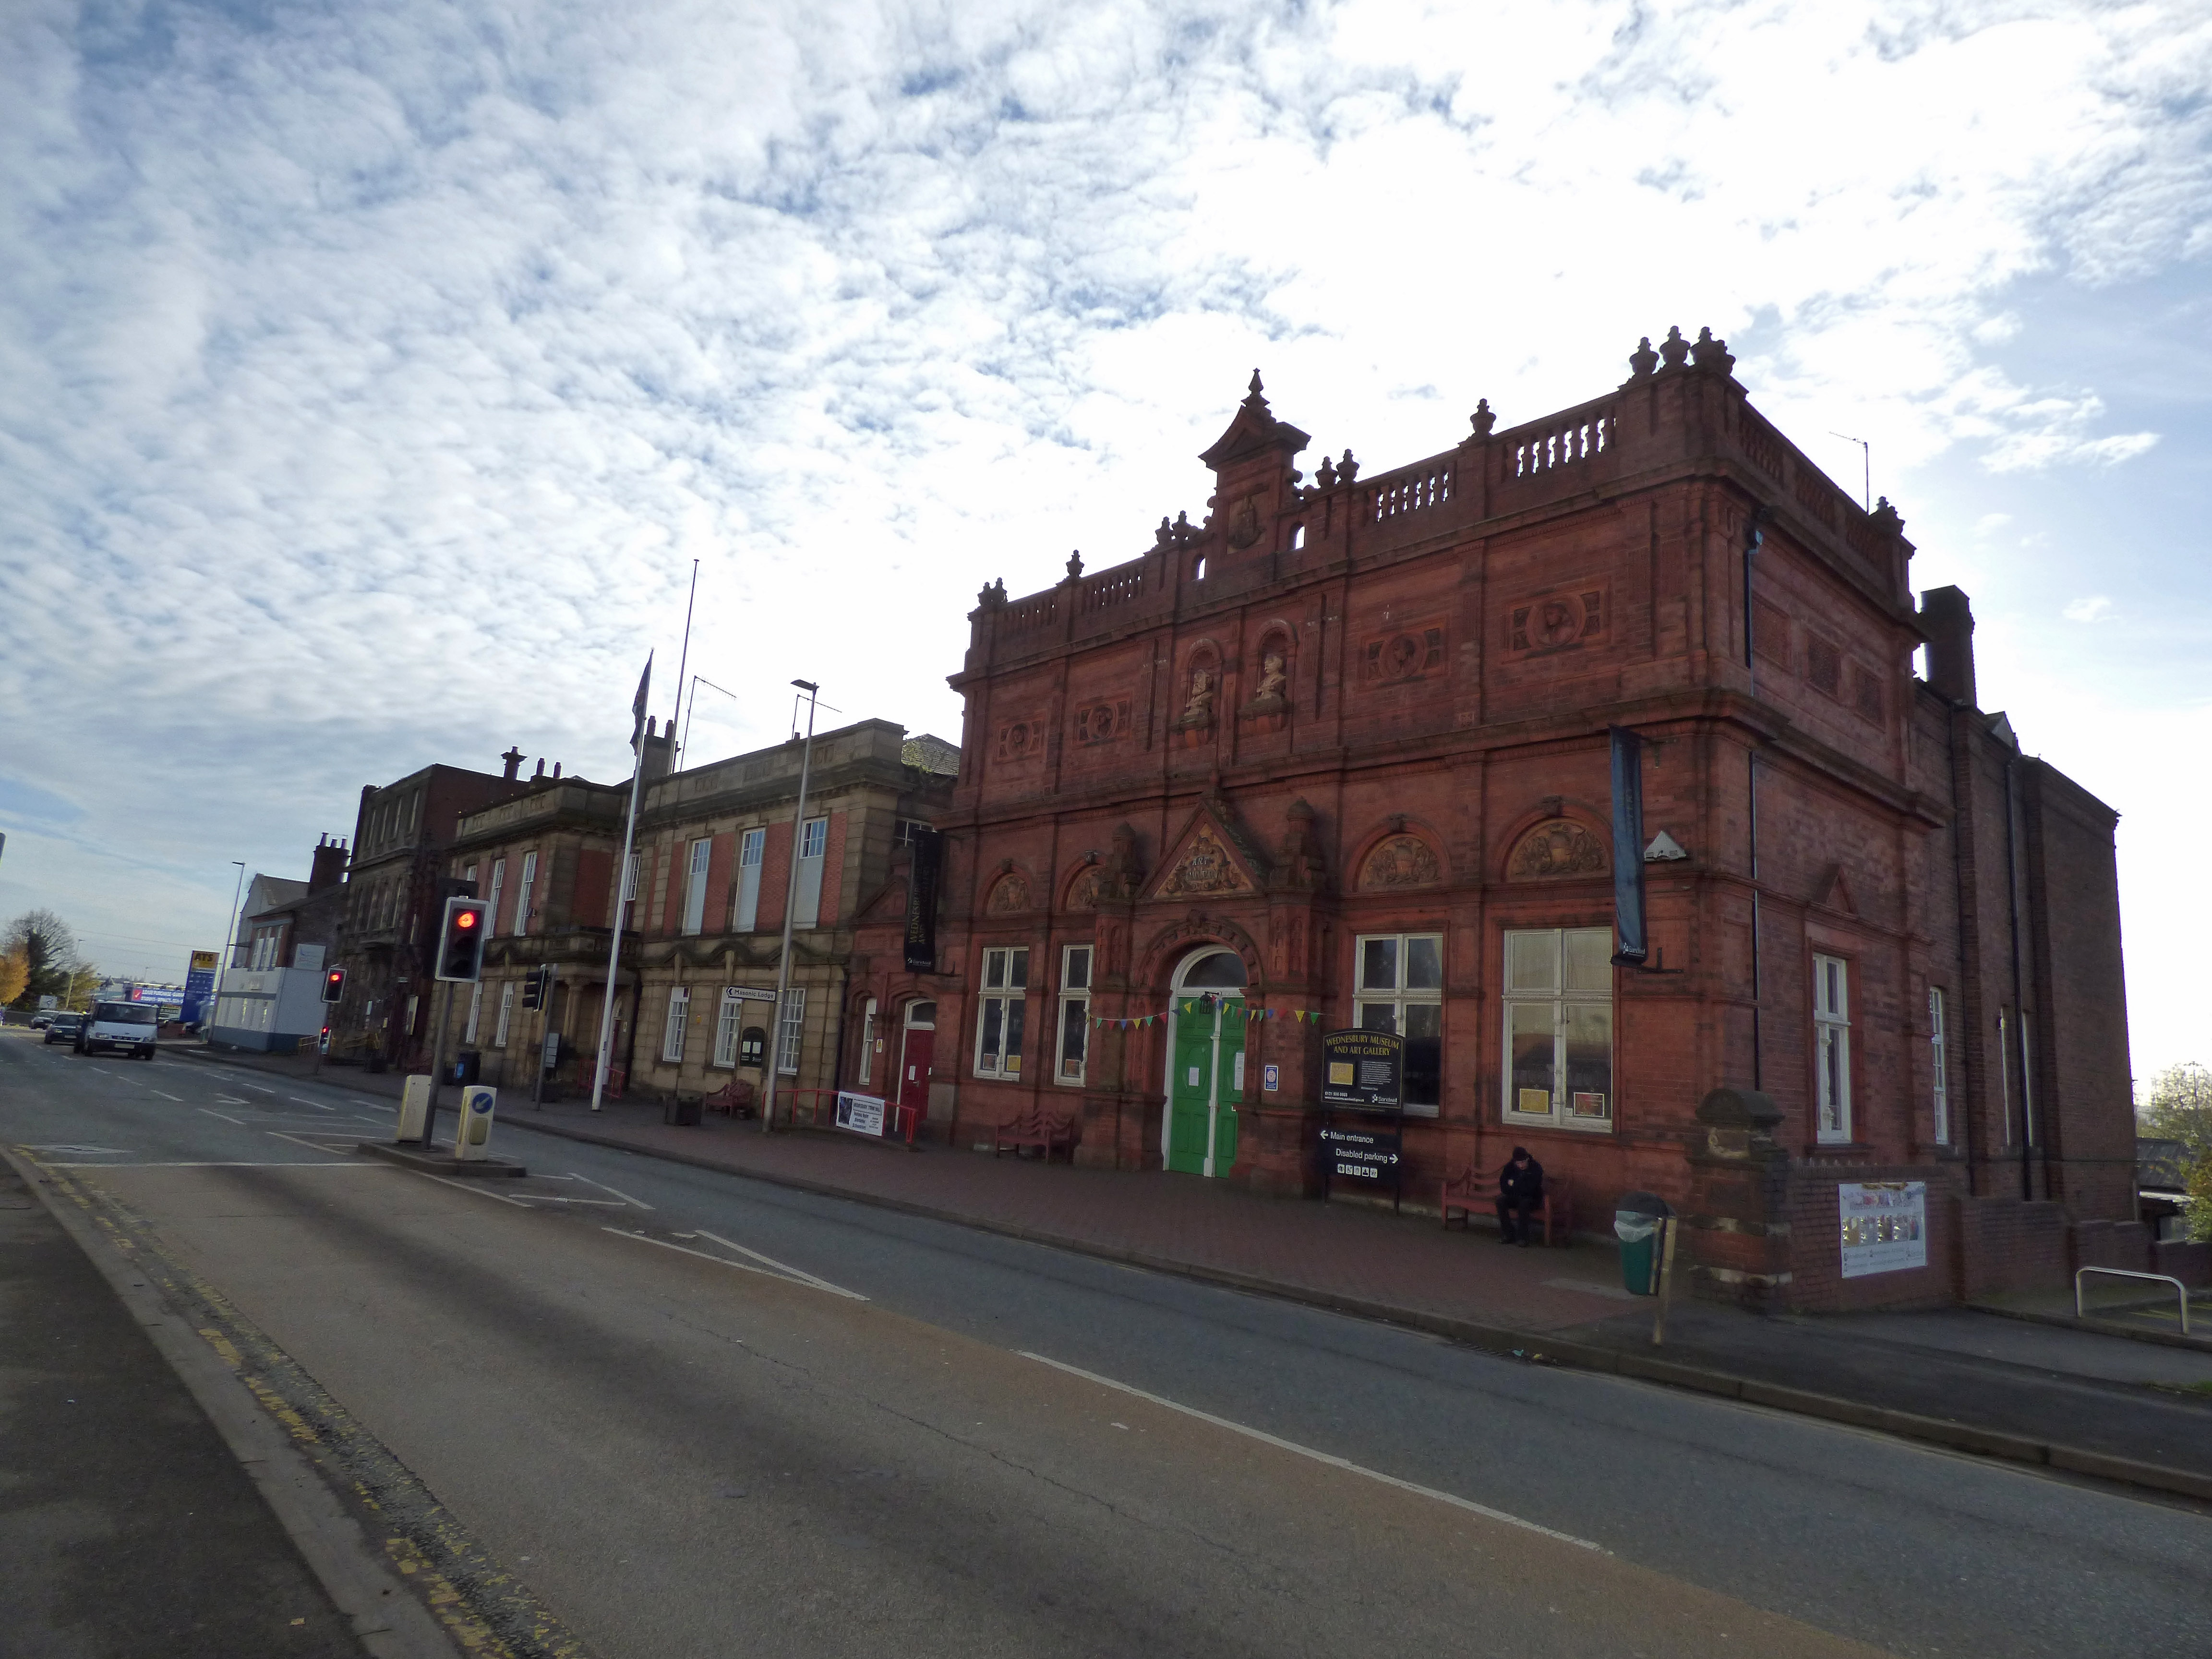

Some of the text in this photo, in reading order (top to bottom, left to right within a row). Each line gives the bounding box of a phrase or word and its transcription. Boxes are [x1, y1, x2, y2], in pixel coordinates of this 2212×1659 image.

[194, 953, 214, 962] ATS
[1326, 1035, 1399, 1049] WEDNESBURY MUSEUM
[1363, 1047, 1391, 1056] GALLERY
[1331, 1131, 1374, 1143] Main entrance
[1336, 1148, 1388, 1164] Disabled parking
